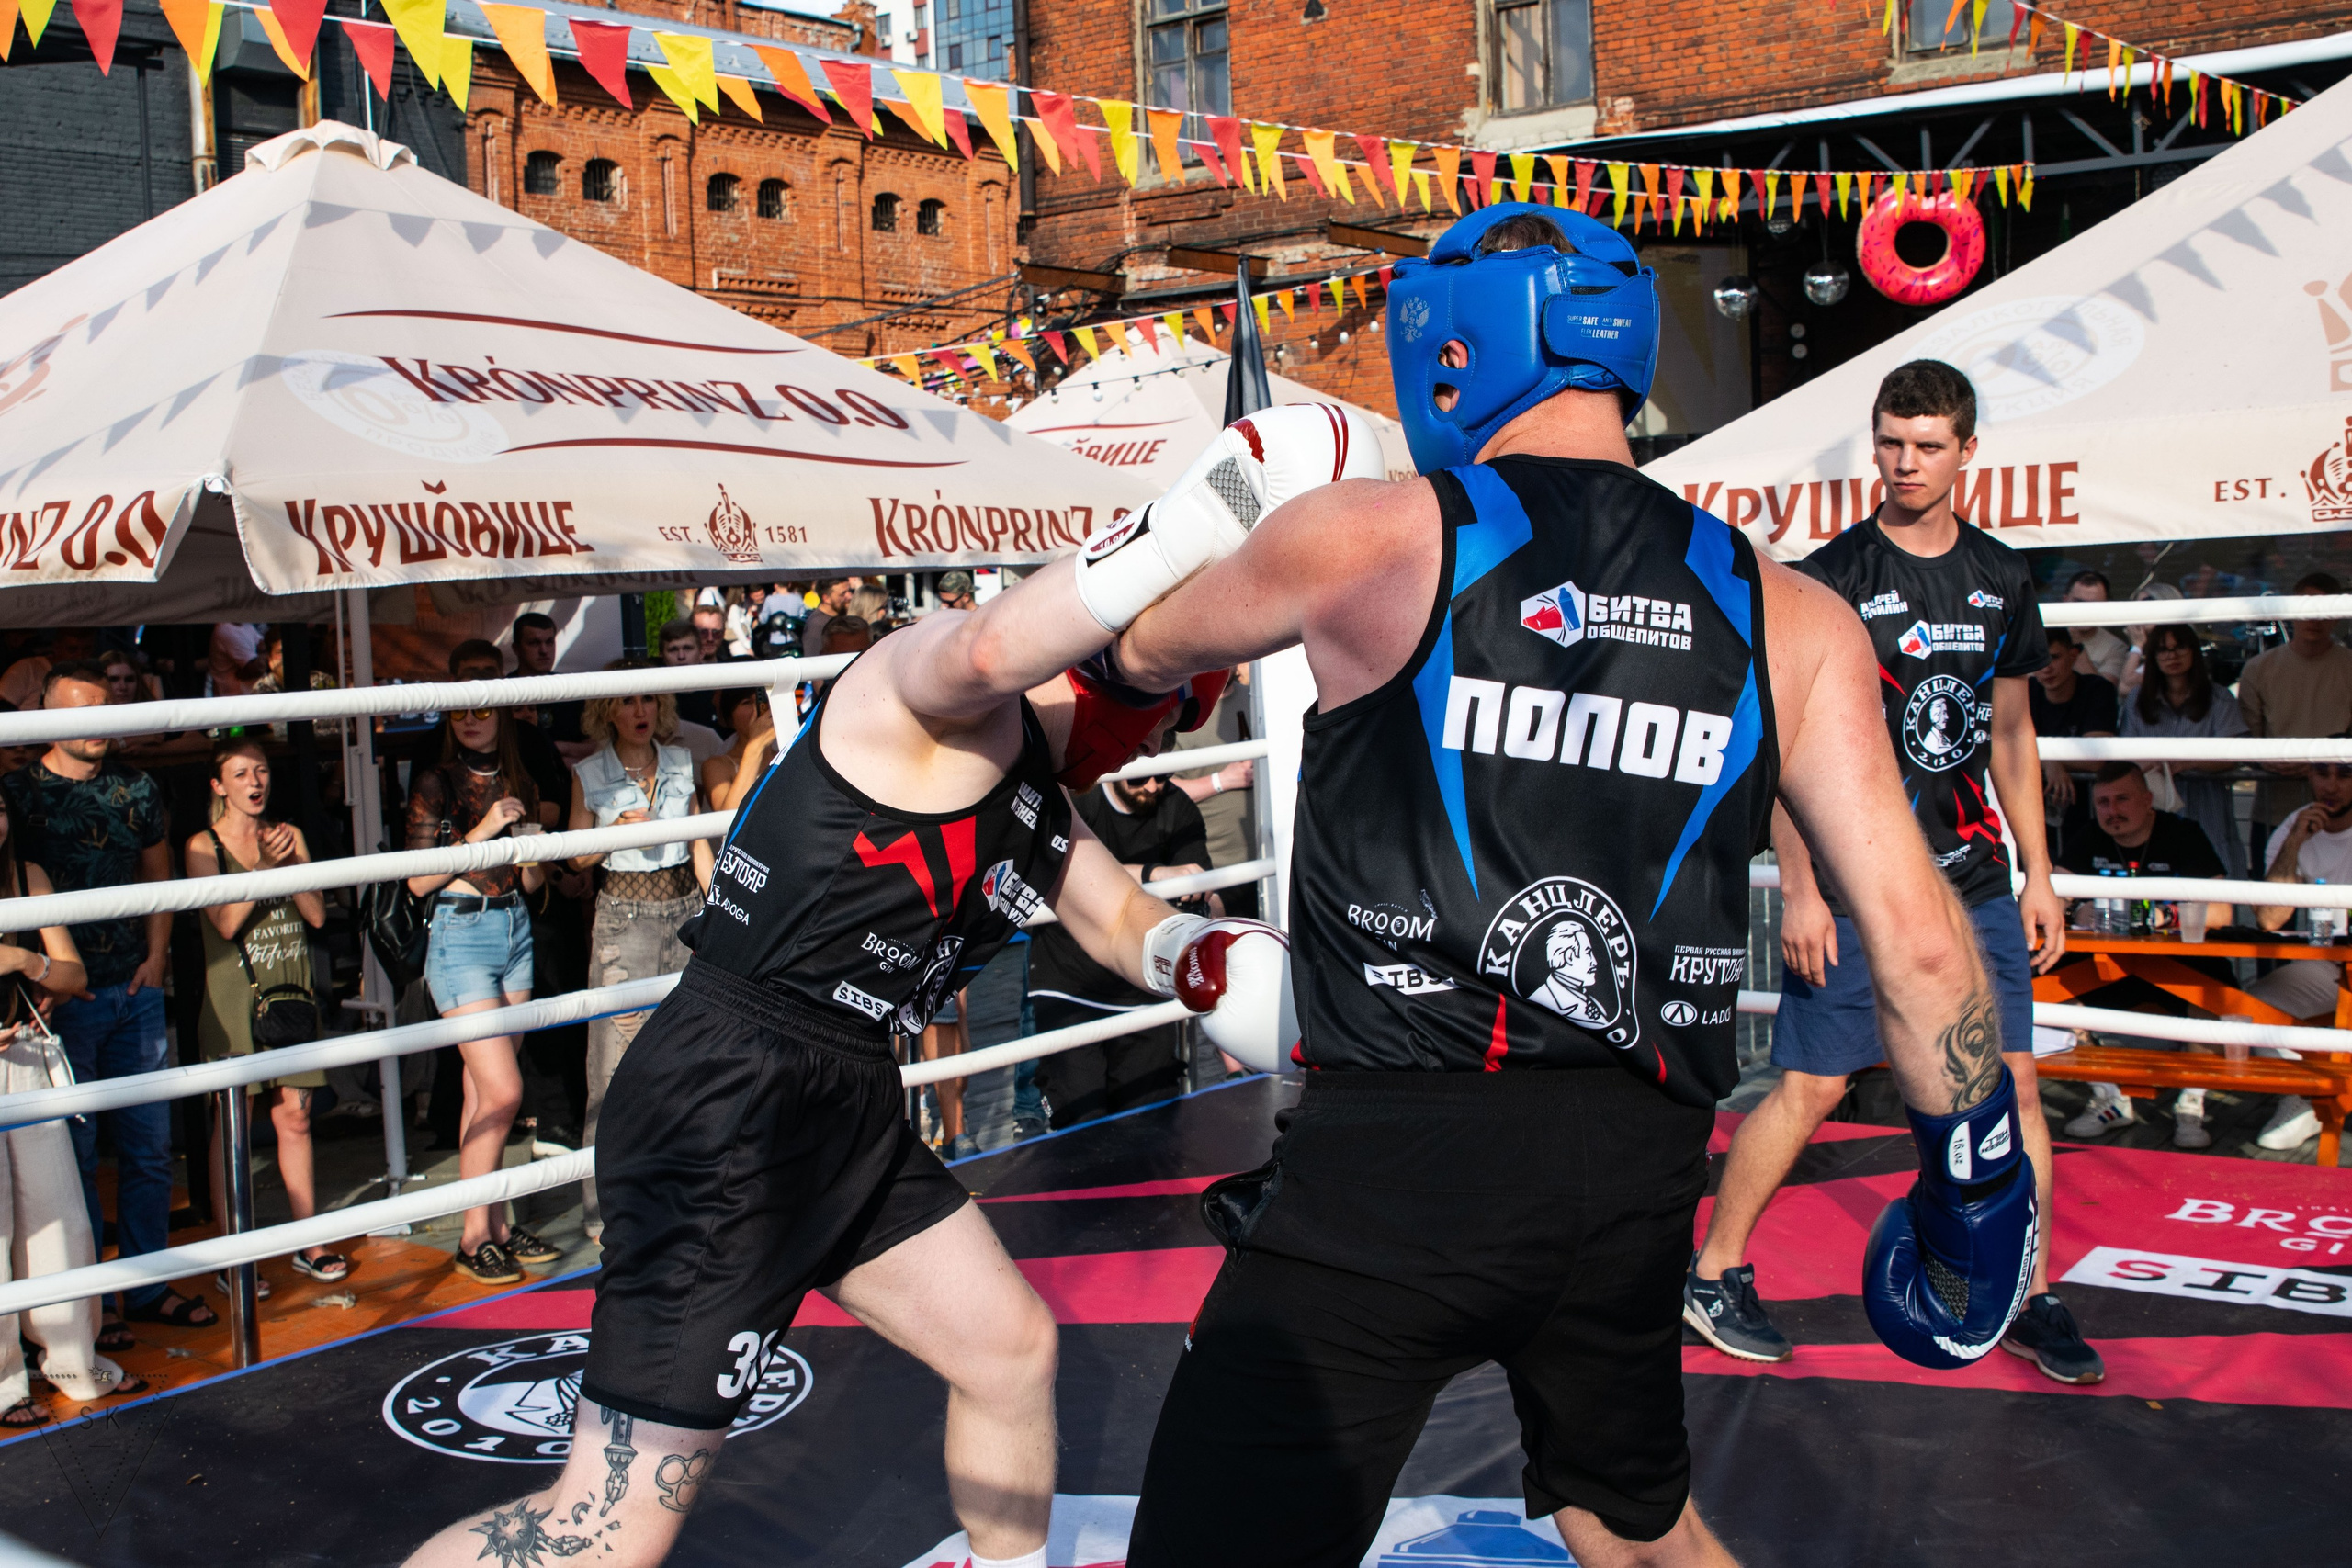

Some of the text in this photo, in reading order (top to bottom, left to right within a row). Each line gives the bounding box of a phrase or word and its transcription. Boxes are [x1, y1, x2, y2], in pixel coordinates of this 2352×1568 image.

[1583, 316, 1599, 326] SAFE
[1613, 318, 1632, 328] SWEAT
[1592, 329, 1619, 340] LEATHER
[775, 384, 910, 430] 0.0
[2214, 477, 2286, 502] EST.
[658, 525, 808, 544] EST. 1581
[1588, 593, 1693, 632] БИТВА
[1587, 625, 1692, 651] ОБЩЕПИТОВ
[1931, 623, 1985, 641] БИТВА
[1932, 641, 1985, 652] ОБЩЕПИТОВ
[1442, 675, 1734, 786] ПОПОВ
[270, 907, 287, 922] MY
[715, 891, 750, 926] LADOGA
[1347, 904, 1436, 942] BROOM
[1485, 884, 1631, 990] КАНЦЛЕРЪ
[1675, 944, 1703, 955] ПЕРВАЯ
[1705, 947, 1731, 956] РУССКАЯ
[838, 987, 891, 1016] SIBS
